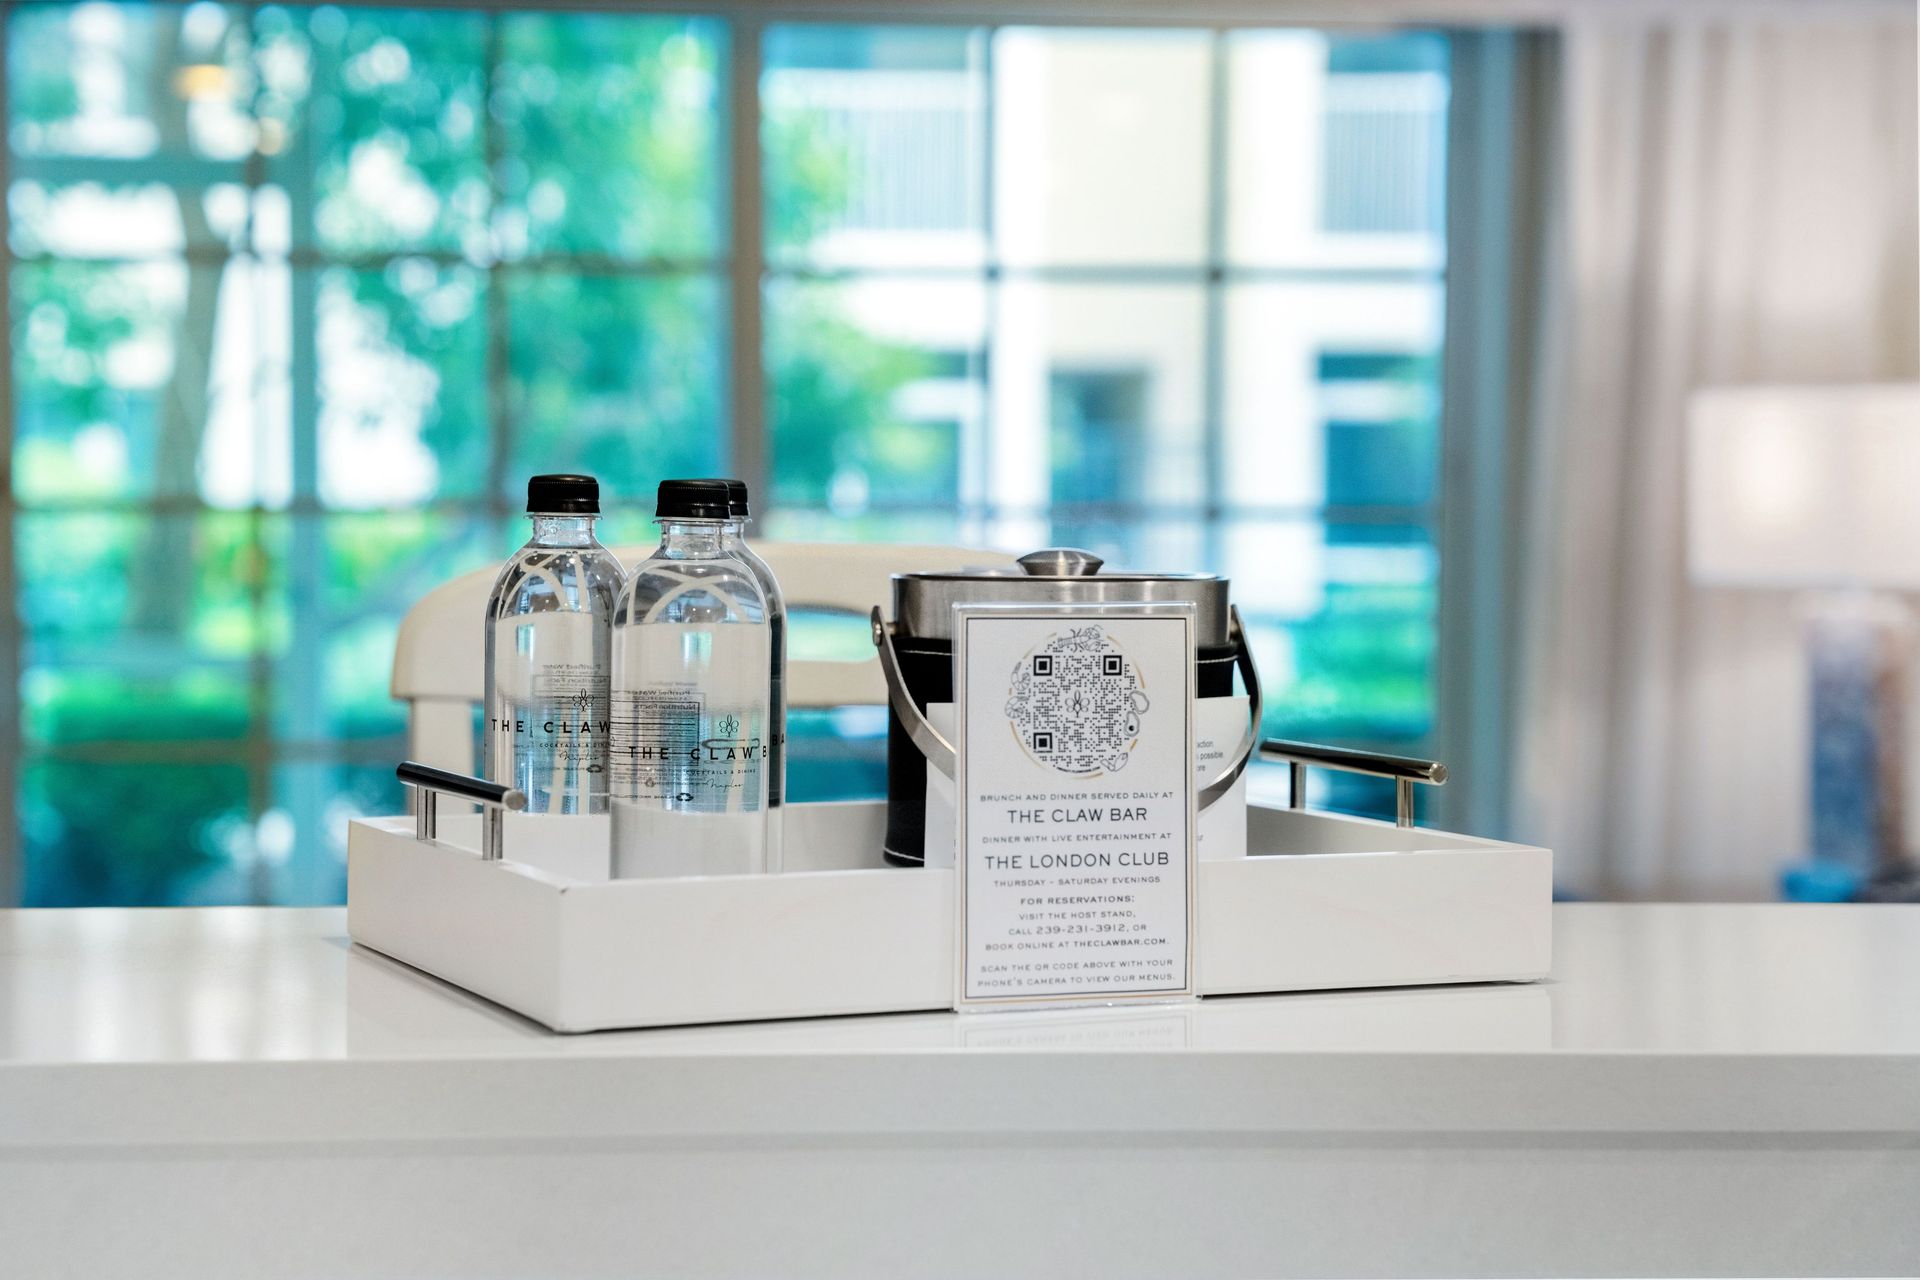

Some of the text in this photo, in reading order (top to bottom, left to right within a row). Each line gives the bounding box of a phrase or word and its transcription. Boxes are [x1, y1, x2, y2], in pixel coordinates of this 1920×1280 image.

[491, 719, 611, 734] THE CLAW
[628, 746, 669, 760] THE
[690, 748, 753, 760] CLAW
[980, 794, 1021, 802] BRUNCH
[1050, 793, 1087, 801] DINNER
[1133, 792, 1158, 800] DAILY
[1008, 808, 1147, 823] THE CLAW BAR
[982, 836, 1020, 844] DINNER
[1024, 835, 1047, 843] WITH
[1052, 835, 1072, 843] LIVE
[1077, 833, 1156, 841] ENTERTAINMENT
[985, 852, 1168, 869] THE LONDON CLUB
[994, 880, 1045, 888] THURSDAY
[1058, 878, 1108, 886] SATURDAY
[1112, 876, 1160, 884] EVENINGS
[1021, 895, 1134, 906] FOR RESERVATIONS:
[1019, 911, 1135, 921] VISIT THE HOST STAND,
[1037, 924, 1128, 934] 239-231-3912,
[1133, 924, 1146, 932] OR
[986, 944, 1013, 952] BOOK
[1017, 942, 1053, 950] ONLINE
[1074, 938, 1169, 948] THECLAWBAR.COM.
[981, 965, 1007, 973] SCAN
[1012, 964, 1030, 972] THE
[1035, 964, 1049, 972] QR
[1053, 962, 1079, 970] CODE
[1083, 961, 1115, 969] ABOVE
[1147, 959, 1172, 967] YOUR
[978, 977, 1023, 987] PHONE'S
[1027, 978, 1066, 986] CAMERA
[1114, 975, 1135, 983] OUR
